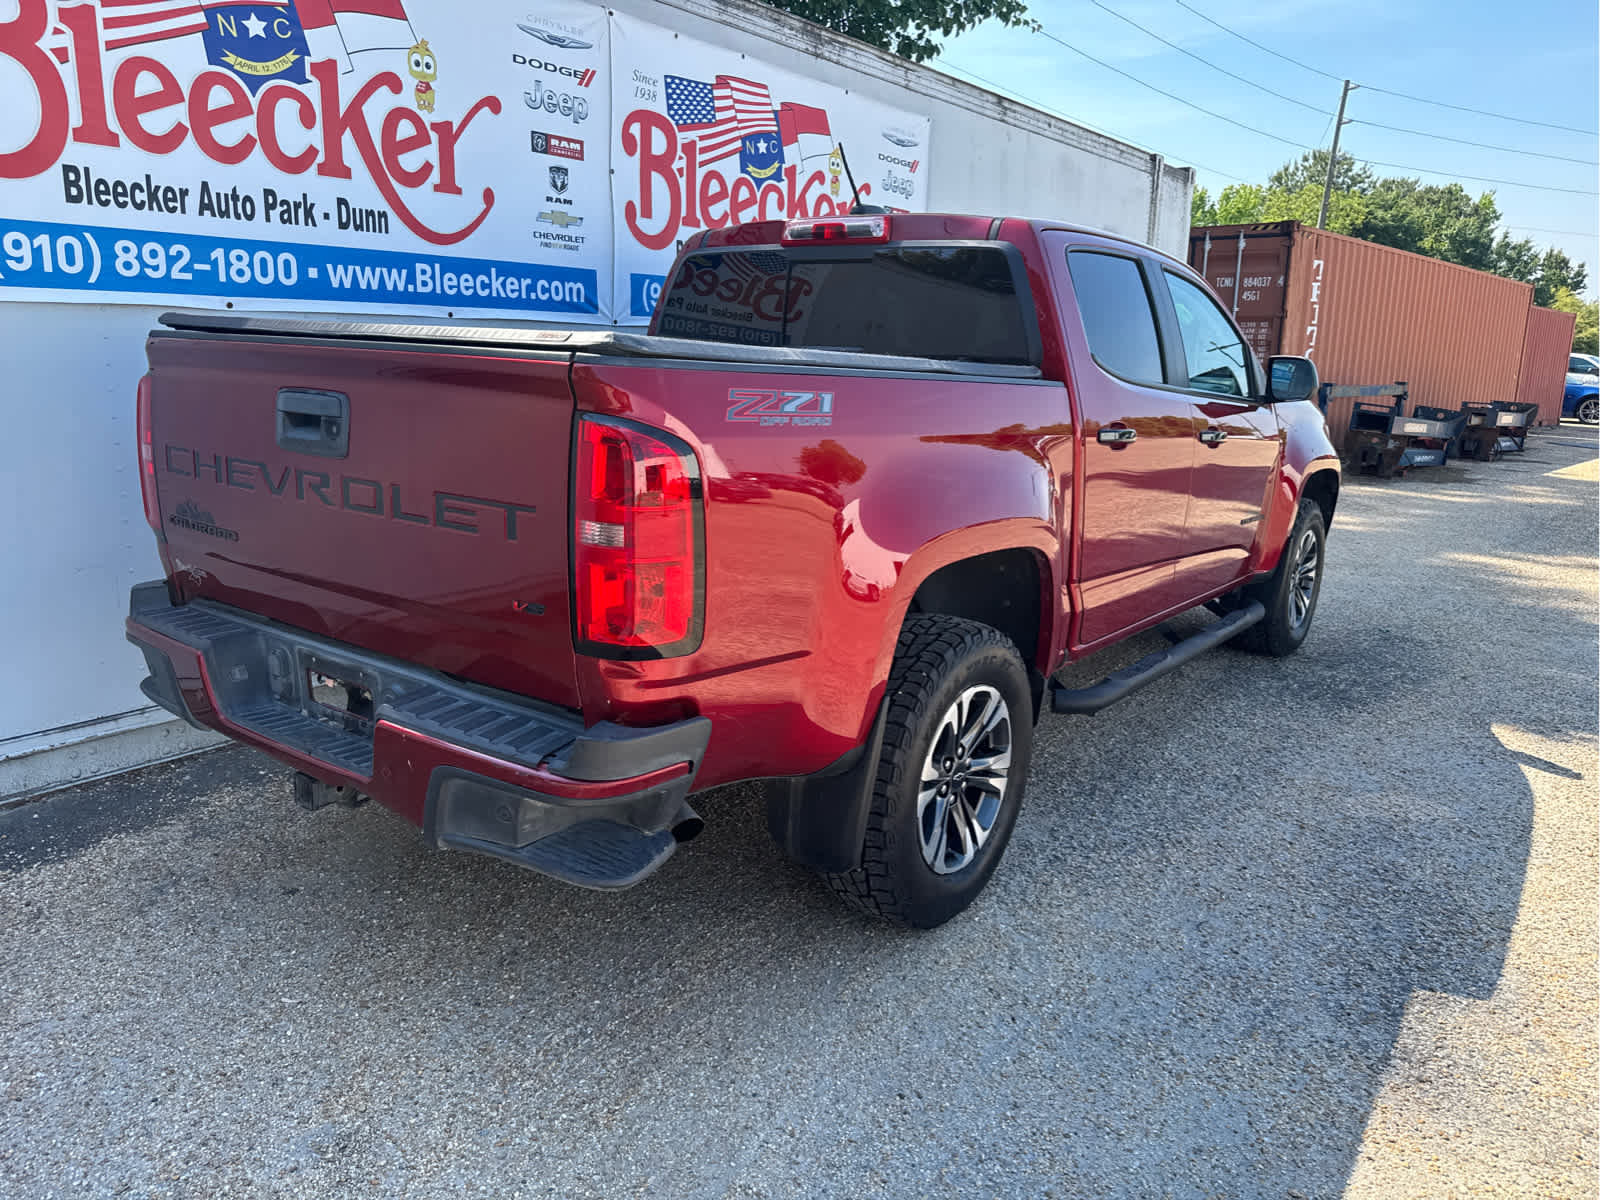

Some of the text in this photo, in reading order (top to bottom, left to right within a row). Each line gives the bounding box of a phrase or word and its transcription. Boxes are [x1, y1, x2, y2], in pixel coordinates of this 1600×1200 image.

[217, 13, 292, 38] N C
[512, 54, 586, 81] DODGE
[632, 69, 659, 87] Since
[524, 79, 589, 124] Jeep
[634, 86, 658, 103] 1938
[550, 138, 581, 151] RAM
[746, 140, 779, 155] N C
[878, 153, 913, 169] DODGE
[881, 169, 915, 200] Jeep
[62, 164, 389, 234] Bleecker Auto Park Dunn
[545, 195, 573, 206] RAM
[533, 231, 585, 244] CHEVROLET
[0, 231, 585, 303] 910) 892-1800 www.Bleecker.com
[1216, 277, 1234, 288] TCNU
[1243, 276, 1272, 288] 884037
[726, 388, 835, 422] Z71
[165, 443, 537, 542] CHEVROLET
